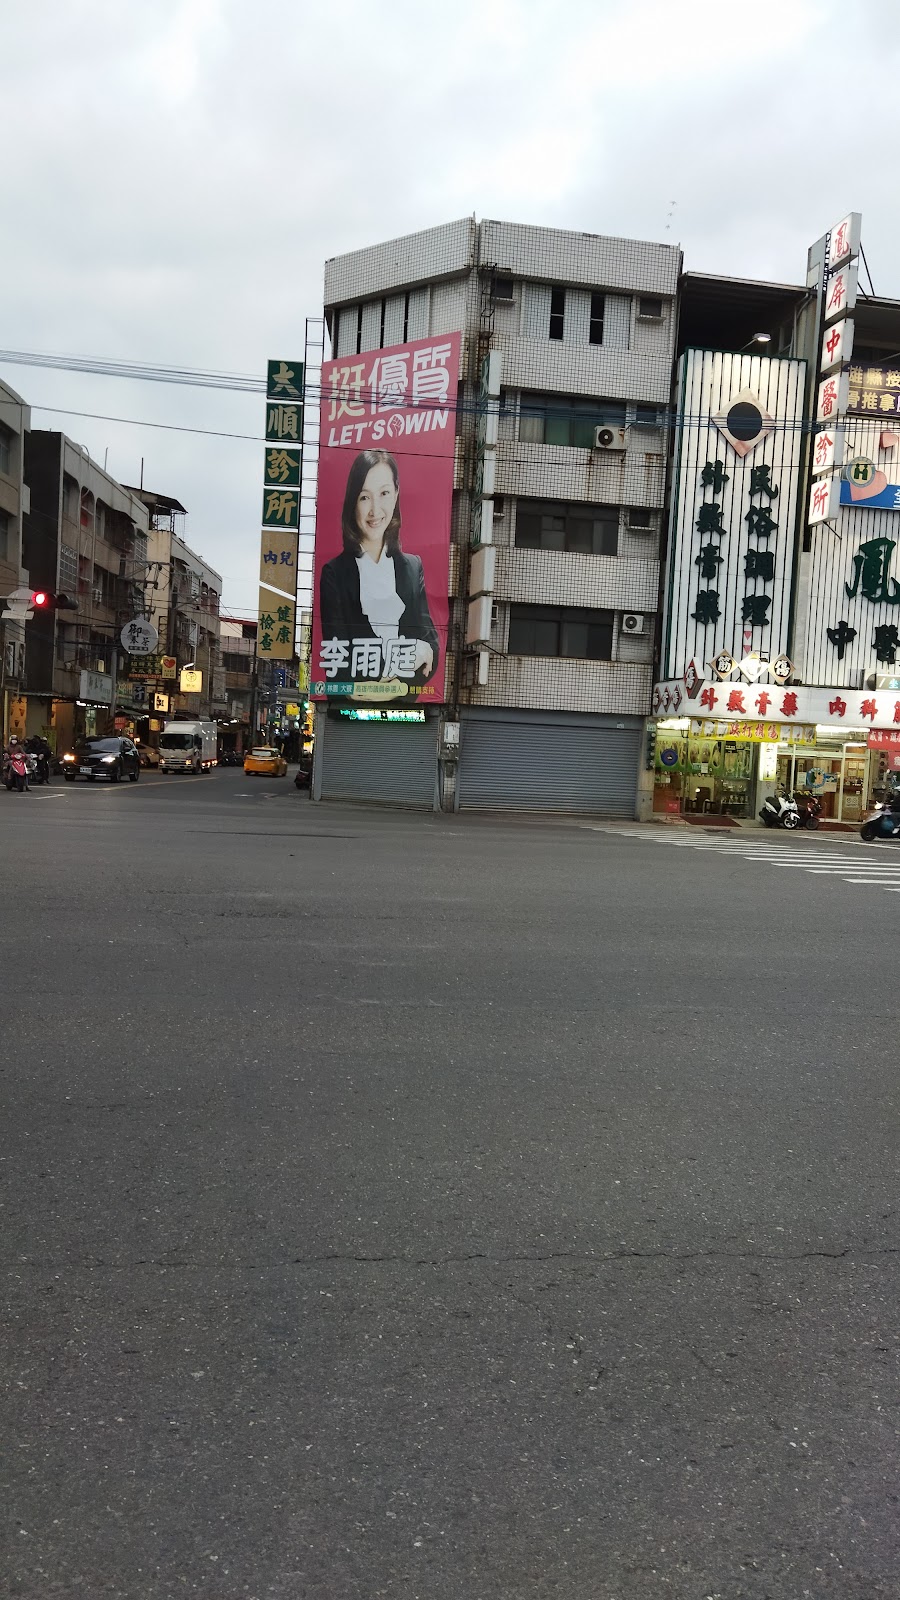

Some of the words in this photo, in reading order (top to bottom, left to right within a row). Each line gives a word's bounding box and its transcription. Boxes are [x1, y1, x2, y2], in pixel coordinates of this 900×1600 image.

[328, 343, 452, 422] 挺優質
[811, 222, 850, 517] 鳳屏中醫診所
[848, 391, 900, 412] 骨推拿
[265, 361, 300, 525] 大順診所
[327, 419, 386, 447] LET'S
[405, 408, 450, 435] WIN
[260, 613, 276, 651] 檢查
[276, 605, 293, 644] 健康
[826, 620, 900, 664] 中醫
[319, 635, 418, 679] 李雨庭
